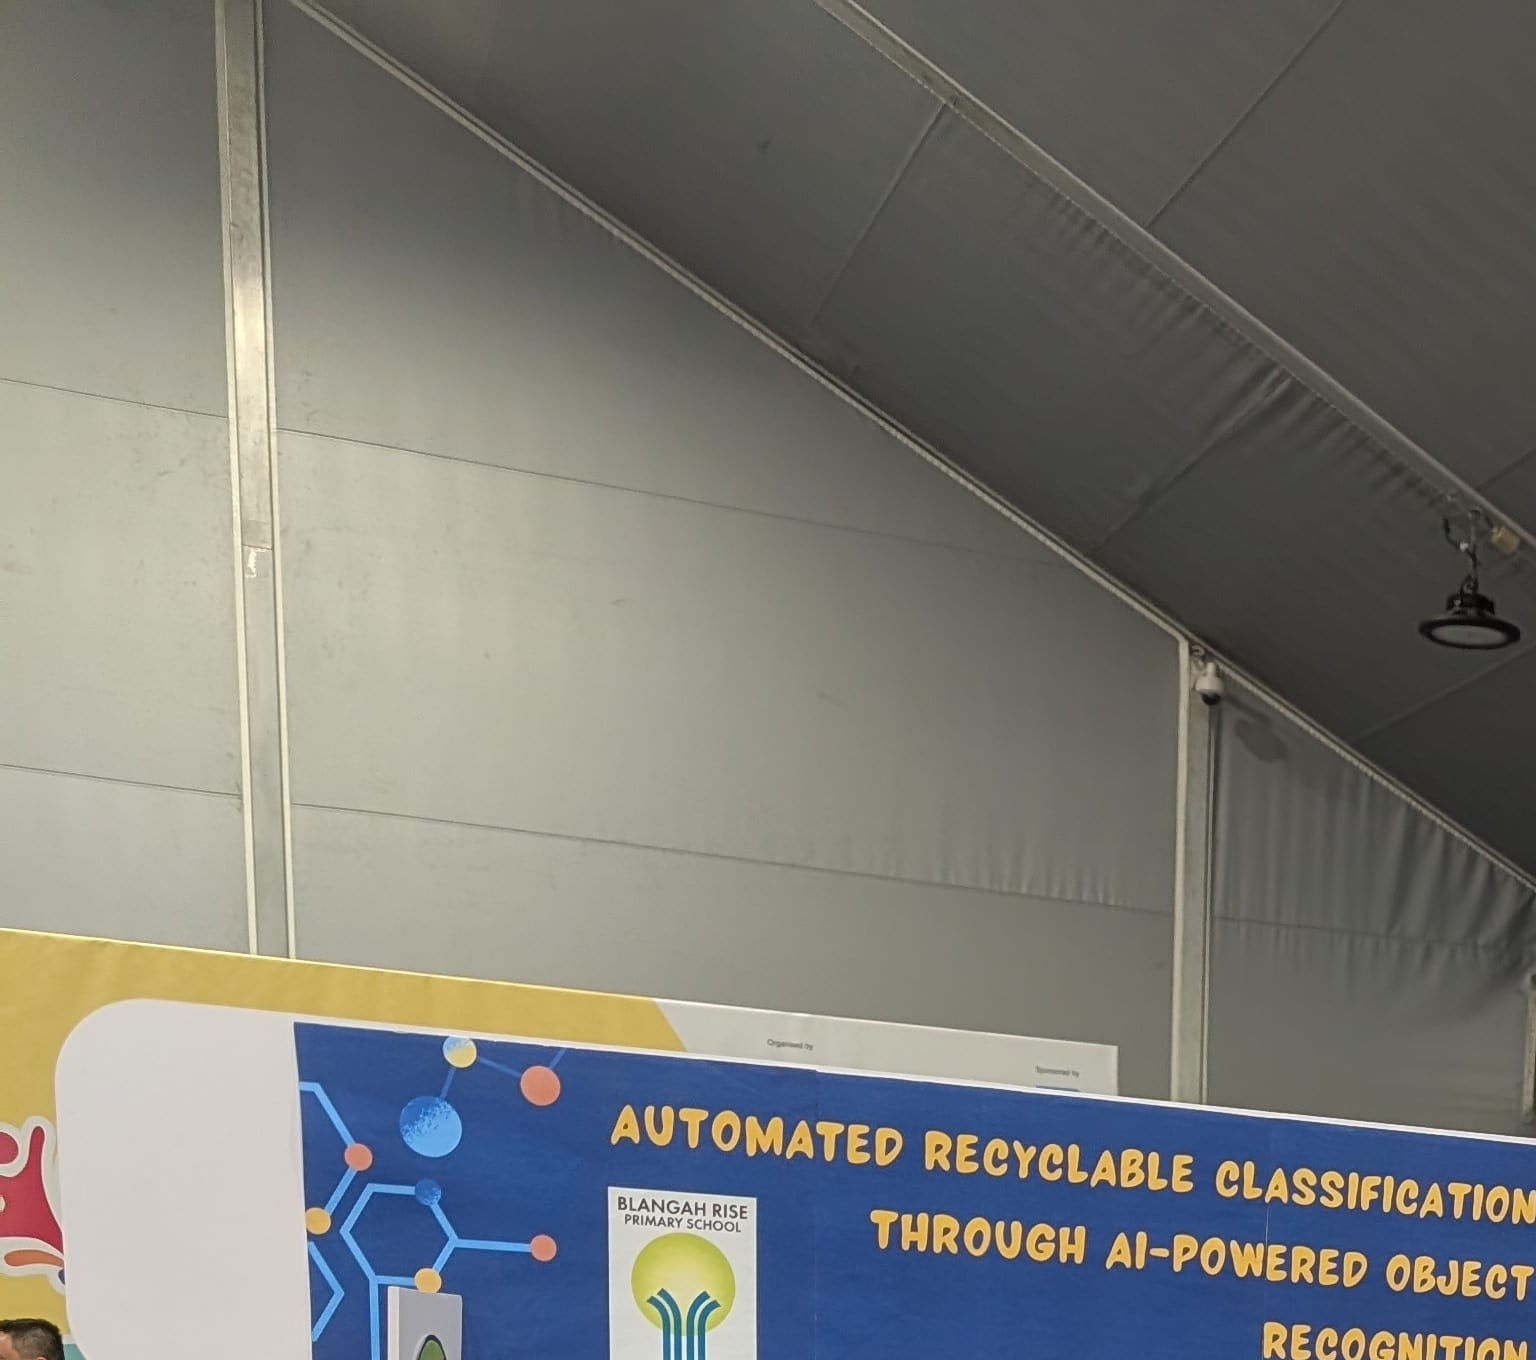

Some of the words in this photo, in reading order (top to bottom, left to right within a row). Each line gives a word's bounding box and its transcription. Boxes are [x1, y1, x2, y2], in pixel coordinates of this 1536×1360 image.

[610, 1104, 903, 1168] AUTOMATED
[925, 1129, 1194, 1194] RECYCLABLE
[617, 1196, 698, 1219] BLANGAH
[704, 1199, 748, 1220] RISE
[624, 1213, 684, 1231] PRIMARY
[687, 1216, 742, 1234] SCHOOL
[870, 1209, 1085, 1264] THROUGH
[1106, 1232, 1368, 1290] AI-POWERED
[1385, 1254, 1535, 1301] OBJECT
